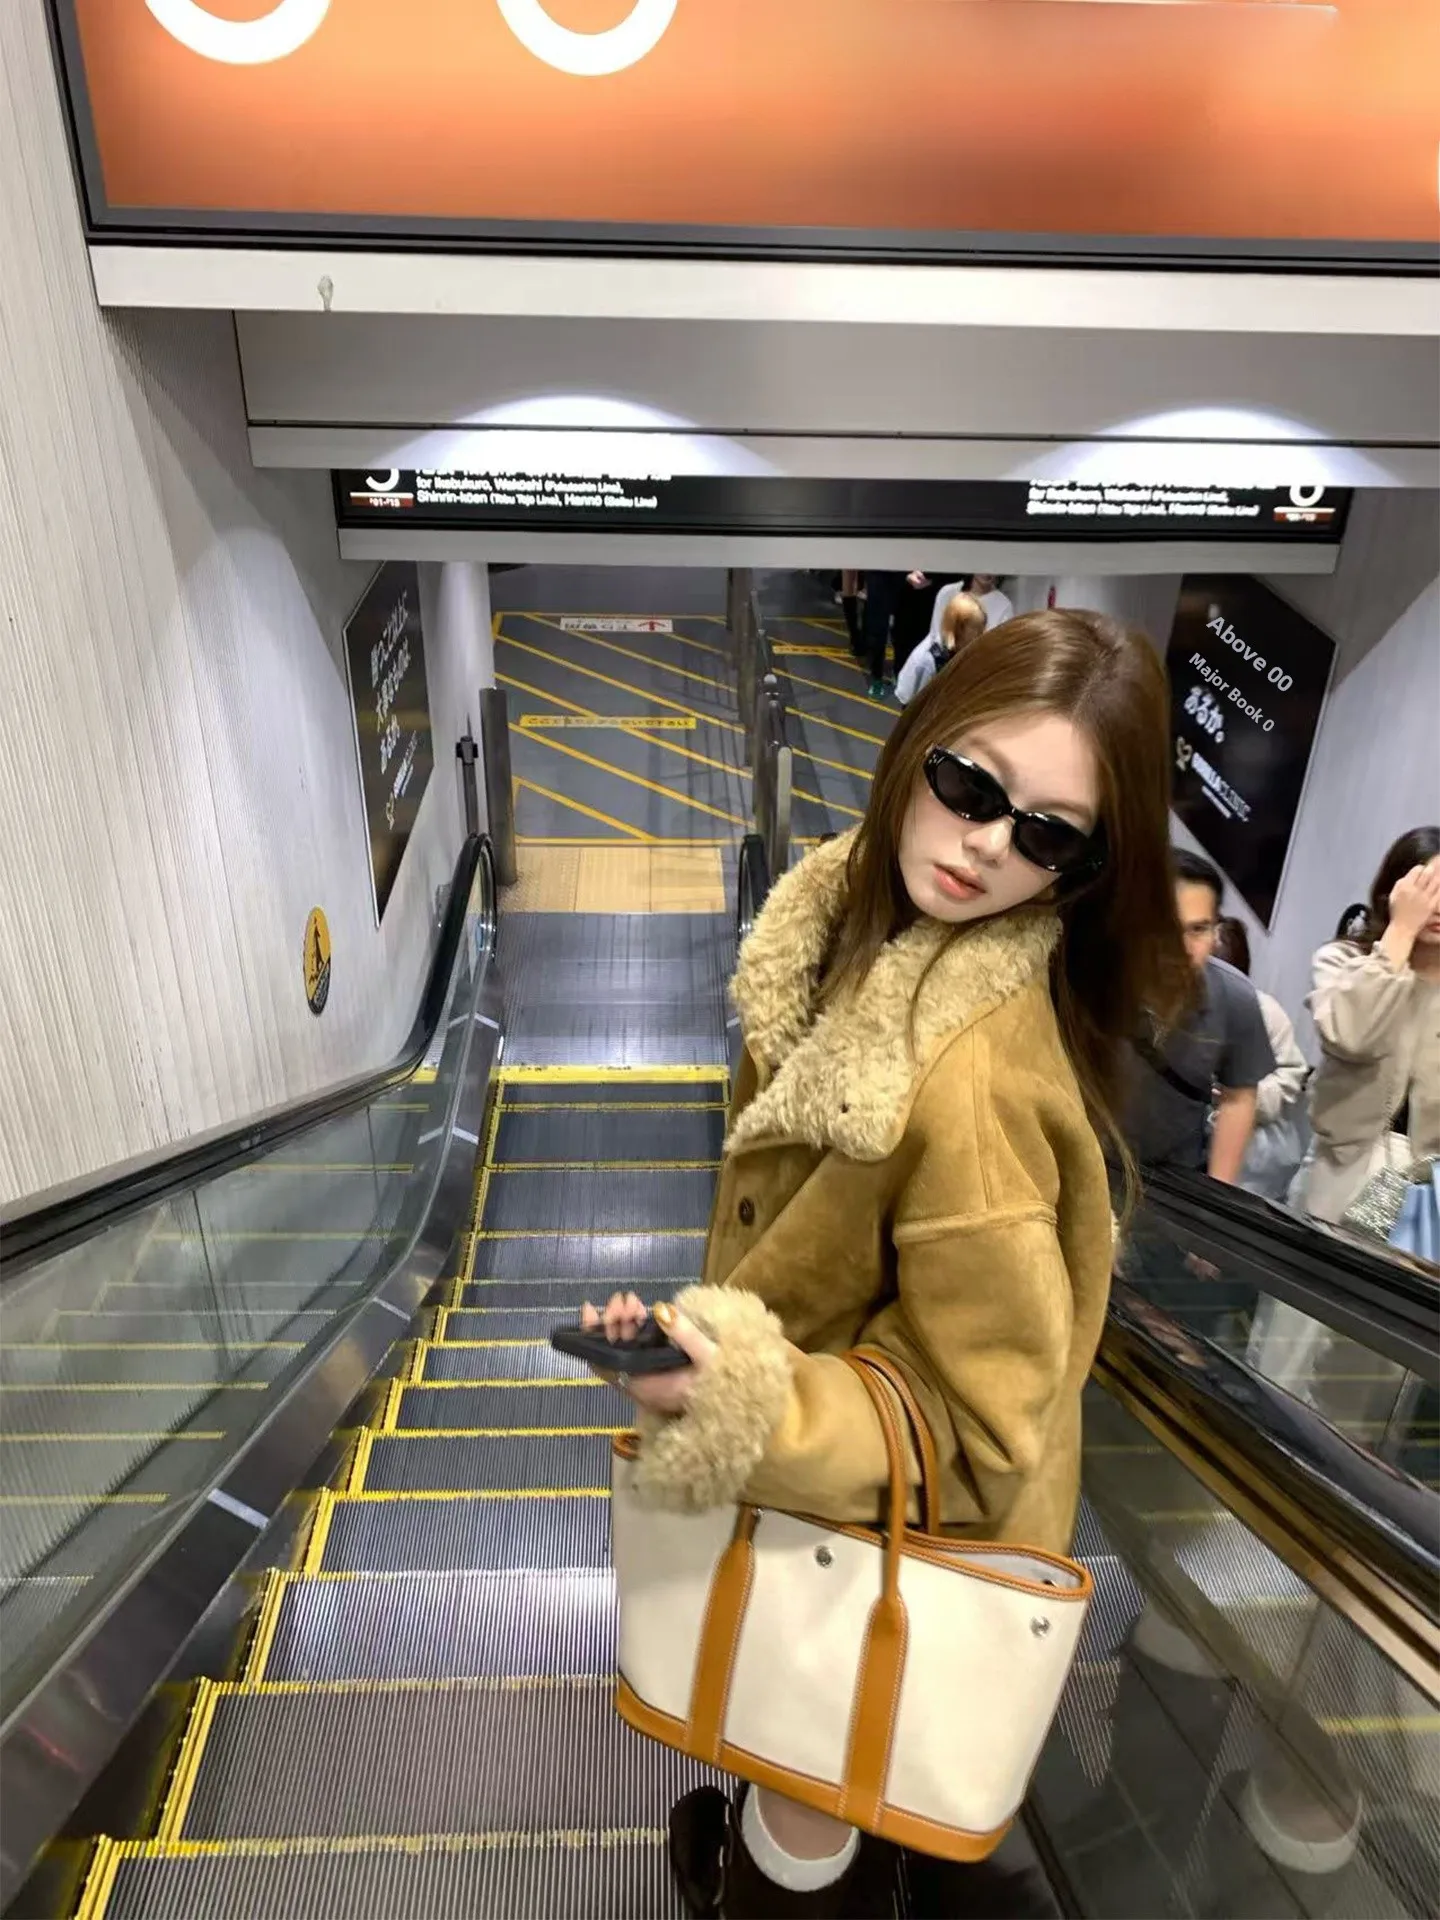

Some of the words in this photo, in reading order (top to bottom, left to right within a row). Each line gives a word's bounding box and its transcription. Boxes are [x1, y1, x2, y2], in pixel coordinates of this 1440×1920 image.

[1206, 616, 1267, 672] Above
[1188, 652, 1230, 691] Major
[1227, 687, 1264, 724] Book
